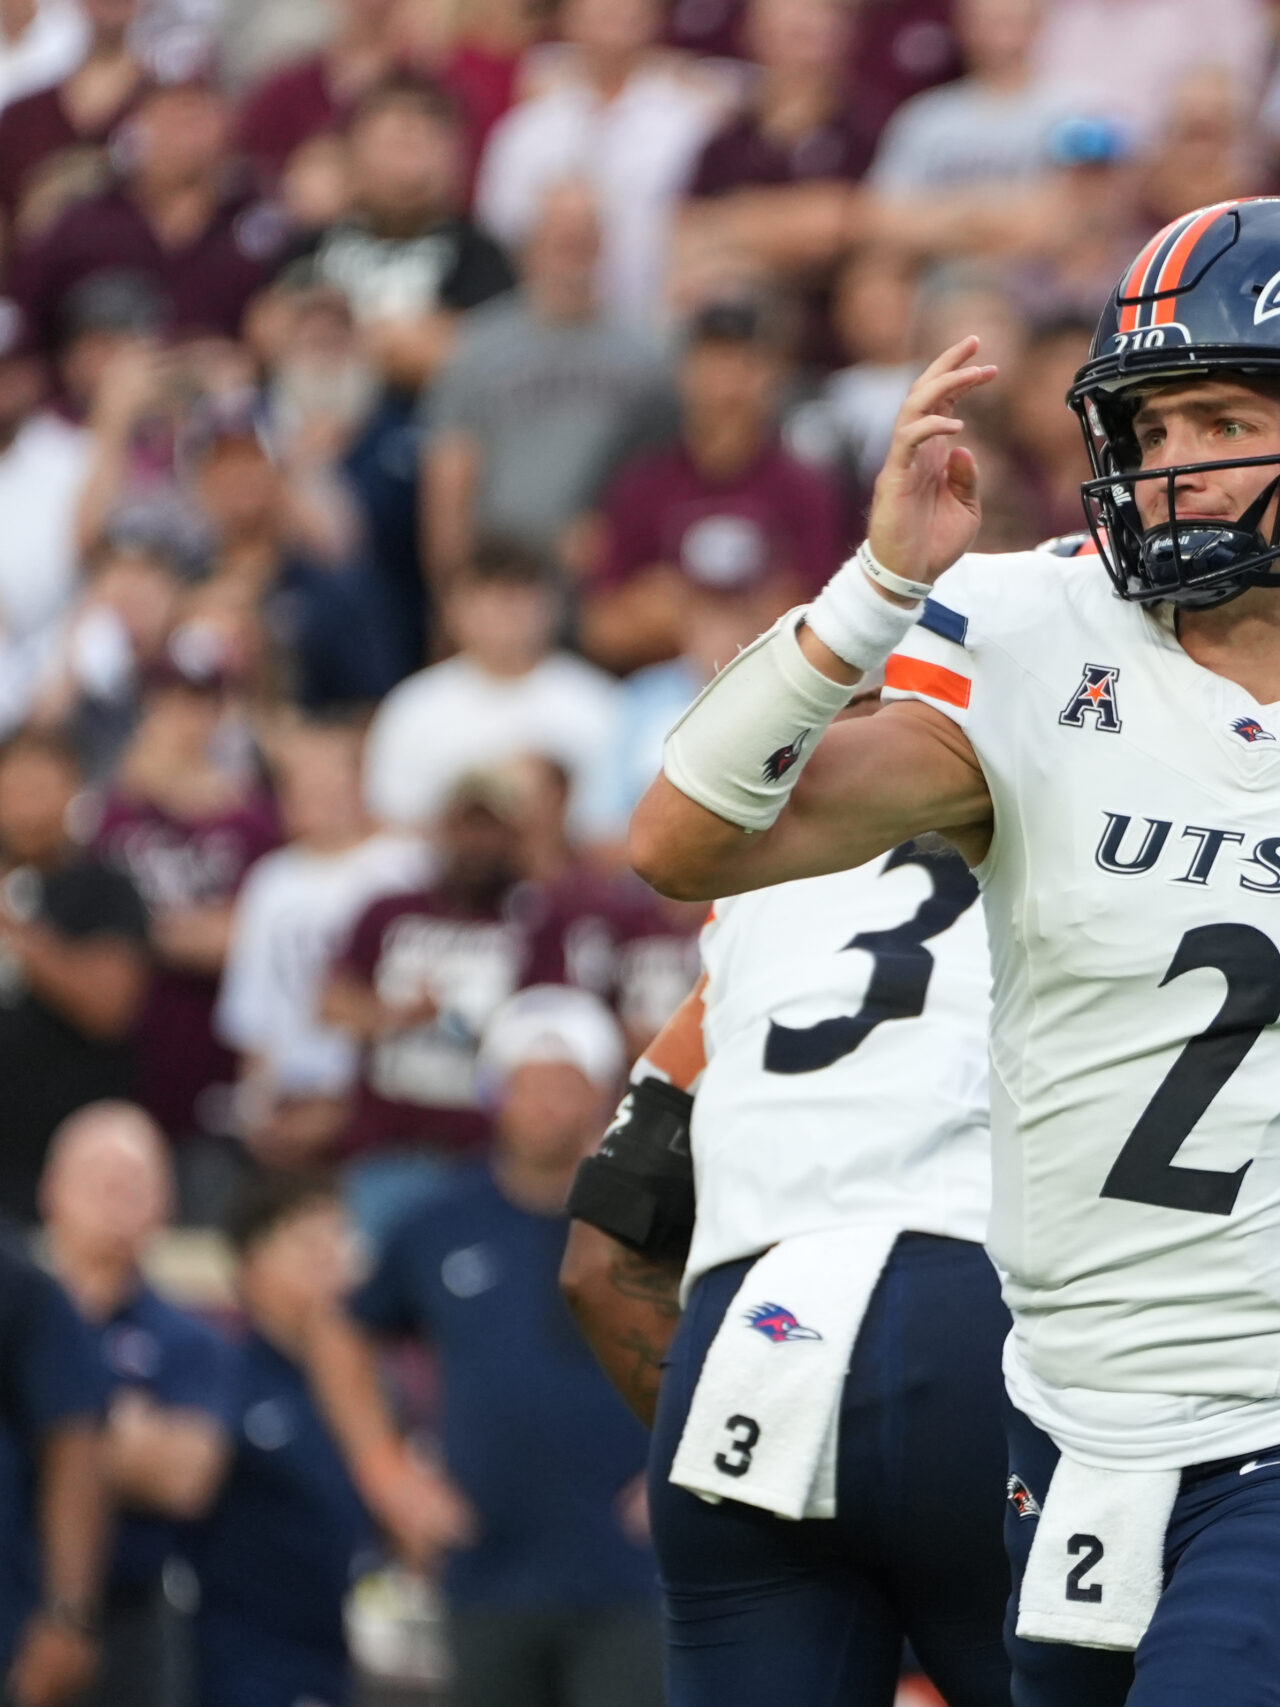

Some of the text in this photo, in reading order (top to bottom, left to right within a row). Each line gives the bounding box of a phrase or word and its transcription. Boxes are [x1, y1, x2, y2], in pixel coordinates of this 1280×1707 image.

[1114, 329, 1165, 354] 210
[1058, 662, 1123, 734] A
[763, 836, 981, 1075] 3
[713, 1413, 760, 1479] 3
[1065, 1532, 1104, 1604] 2
